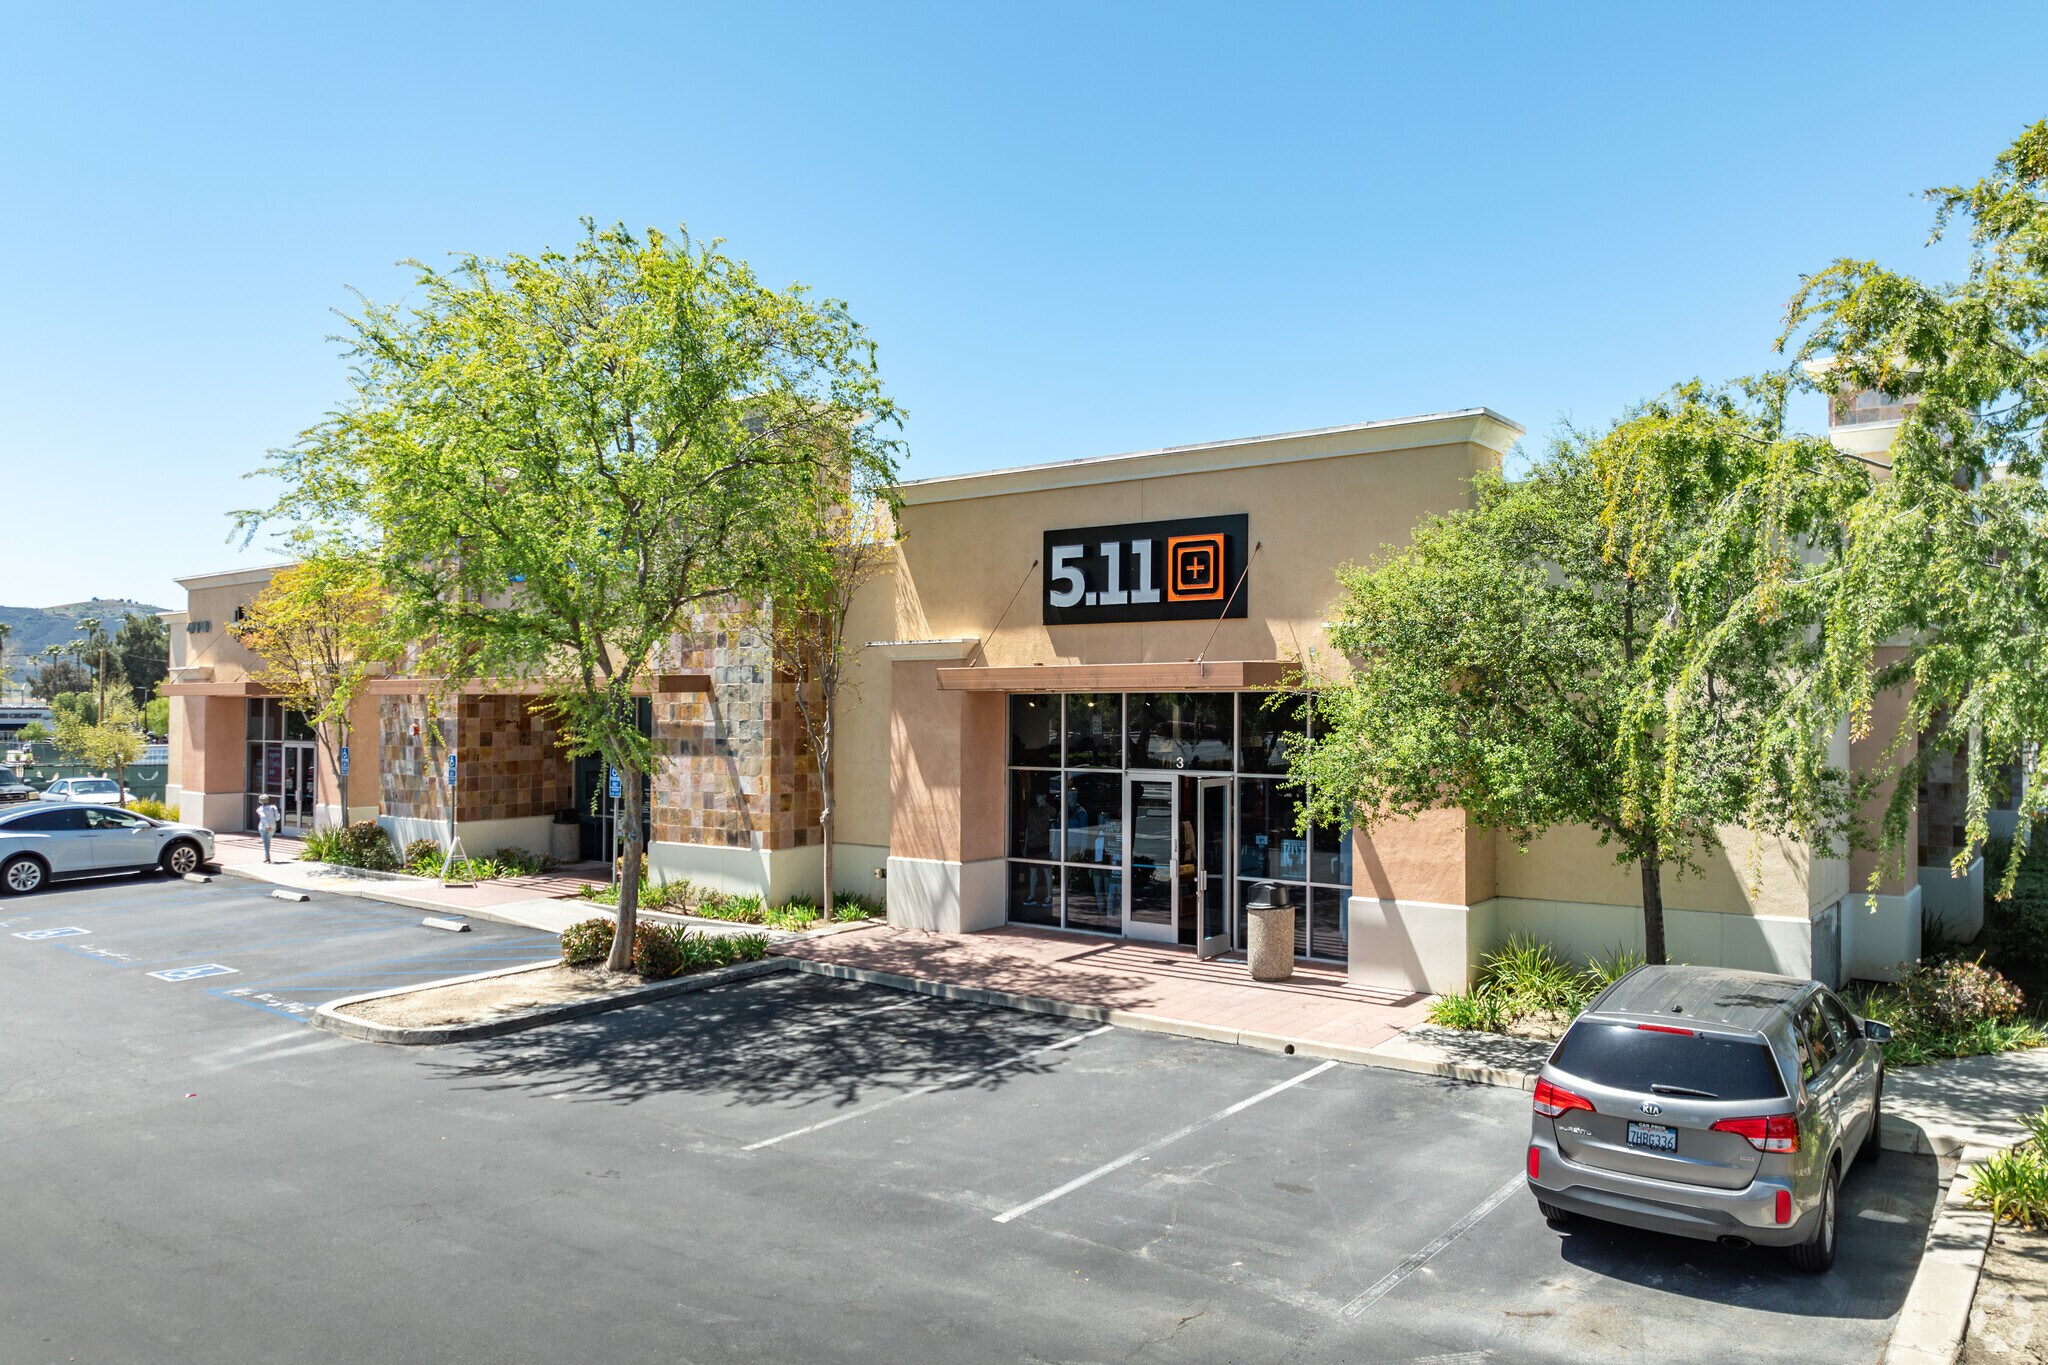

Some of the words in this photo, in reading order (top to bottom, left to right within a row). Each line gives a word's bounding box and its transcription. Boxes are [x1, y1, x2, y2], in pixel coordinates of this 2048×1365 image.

[1050, 538, 1160, 608] 5.11
[1176, 757, 1184, 769] 3
[1643, 1104, 1660, 1117] KIA
[1630, 1130, 1674, 1149] 7HBG336
